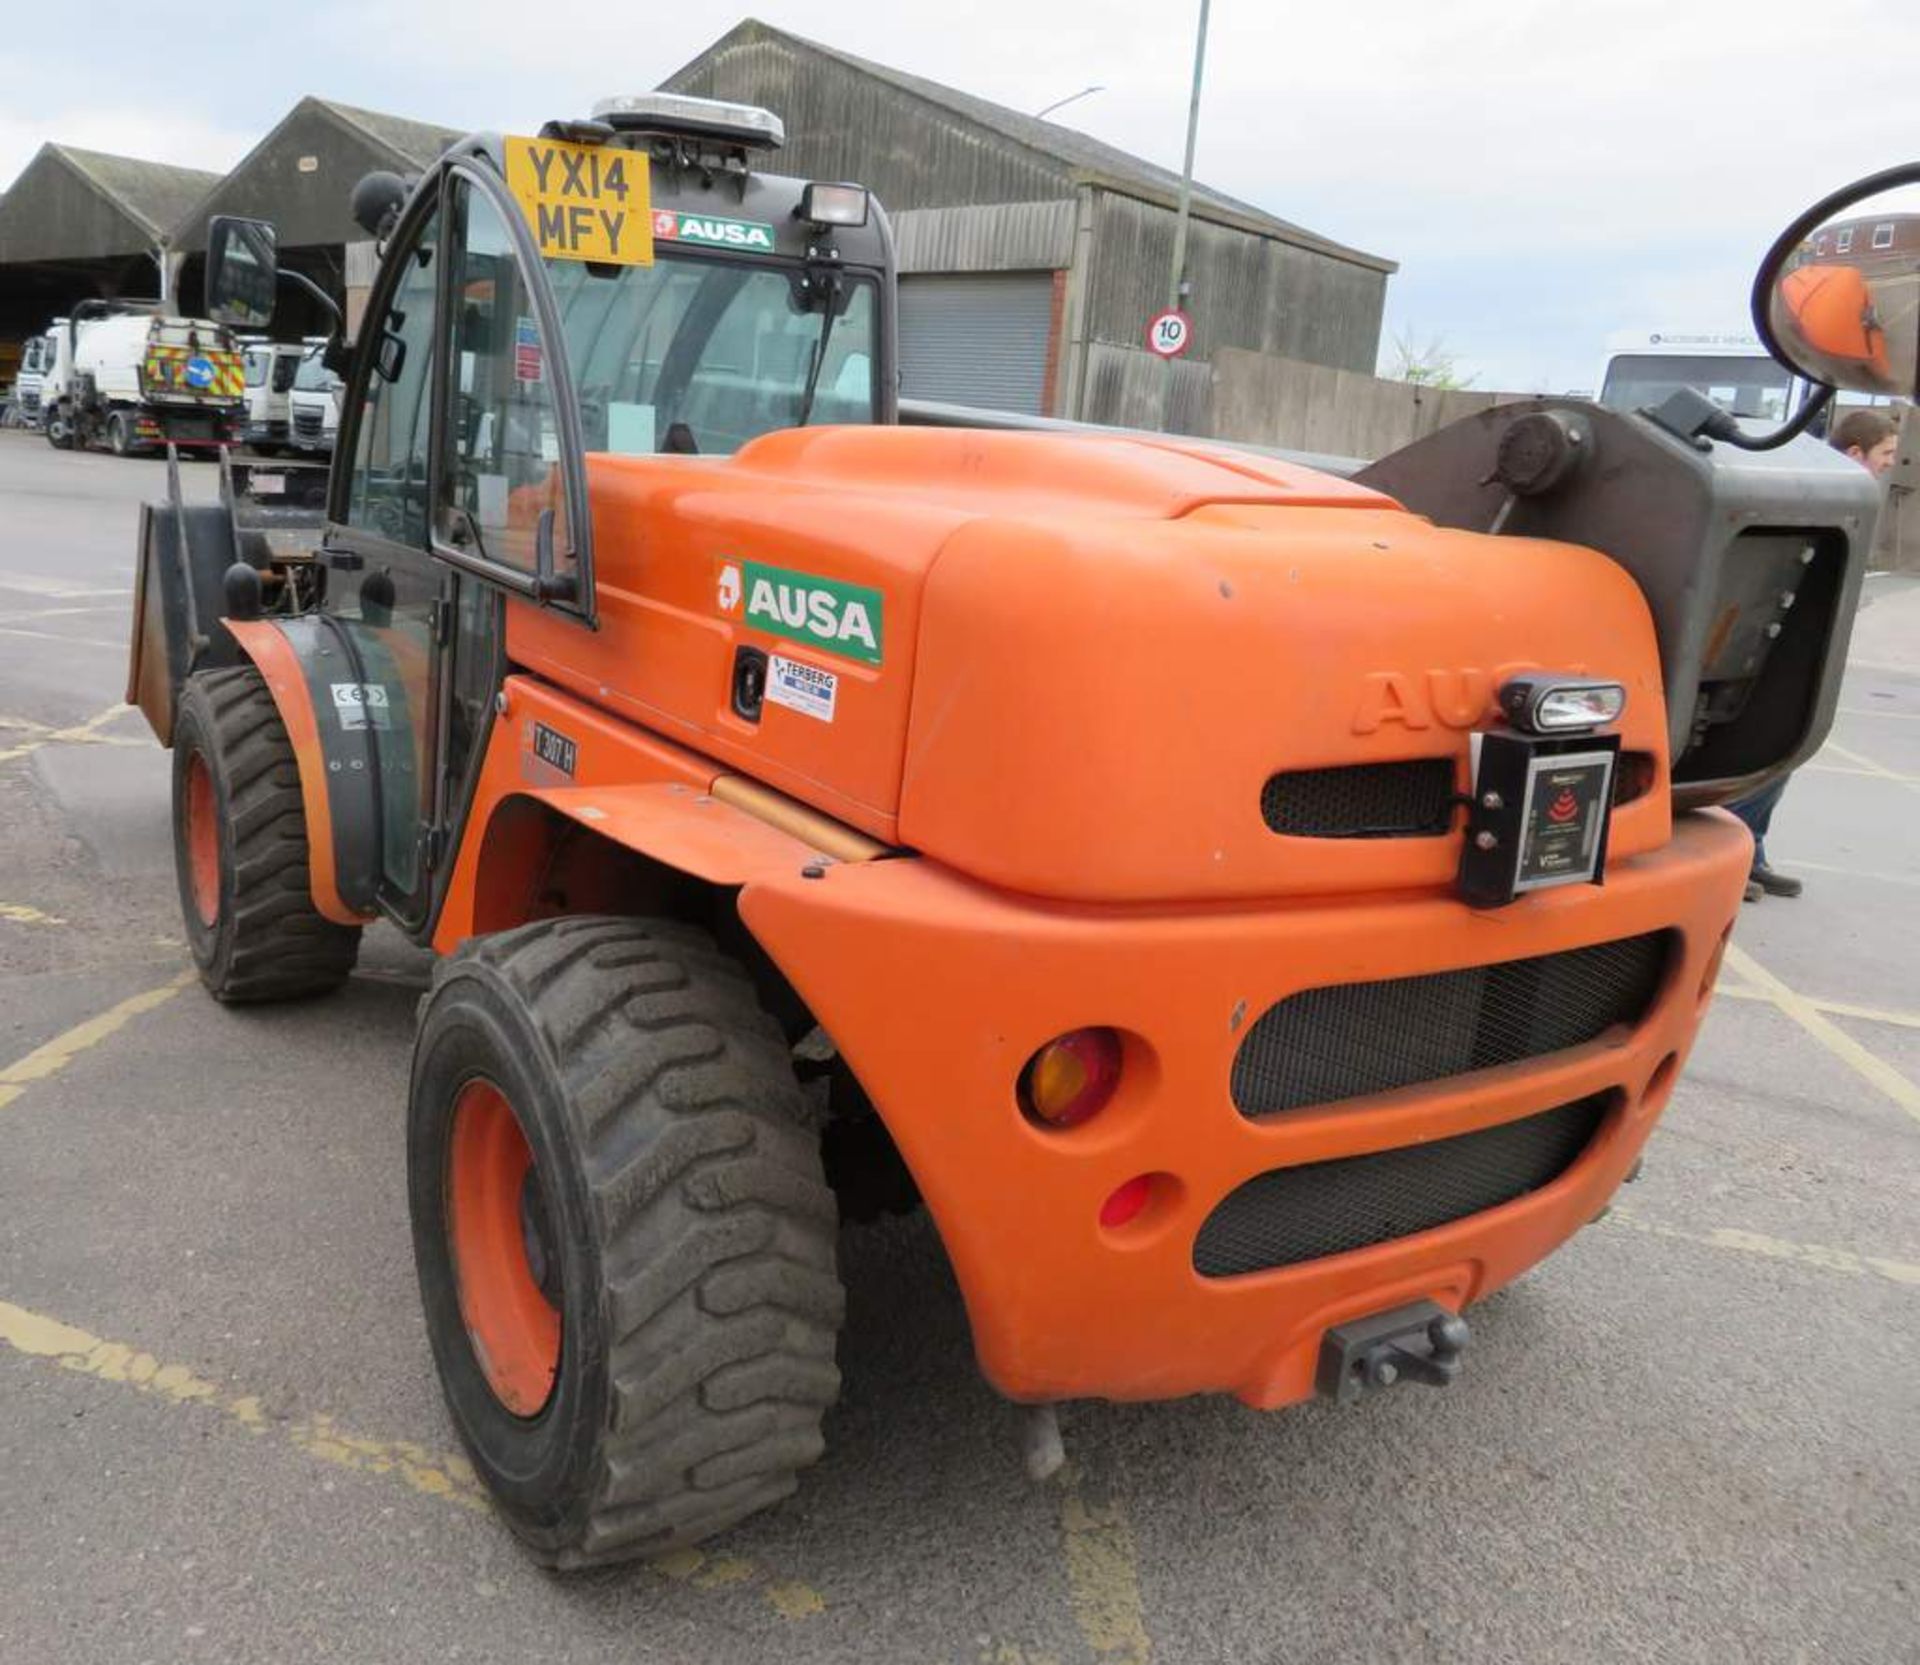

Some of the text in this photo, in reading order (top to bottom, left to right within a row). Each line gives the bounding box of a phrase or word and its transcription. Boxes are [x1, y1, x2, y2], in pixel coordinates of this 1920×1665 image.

[528, 146, 629, 201] YX14
[537, 203, 624, 255] MFY
[681, 219, 771, 247] AUSA
[1160, 320, 1182, 340] 10
[748, 578, 877, 649] AUSA
[786, 661, 833, 689] TERBERG
